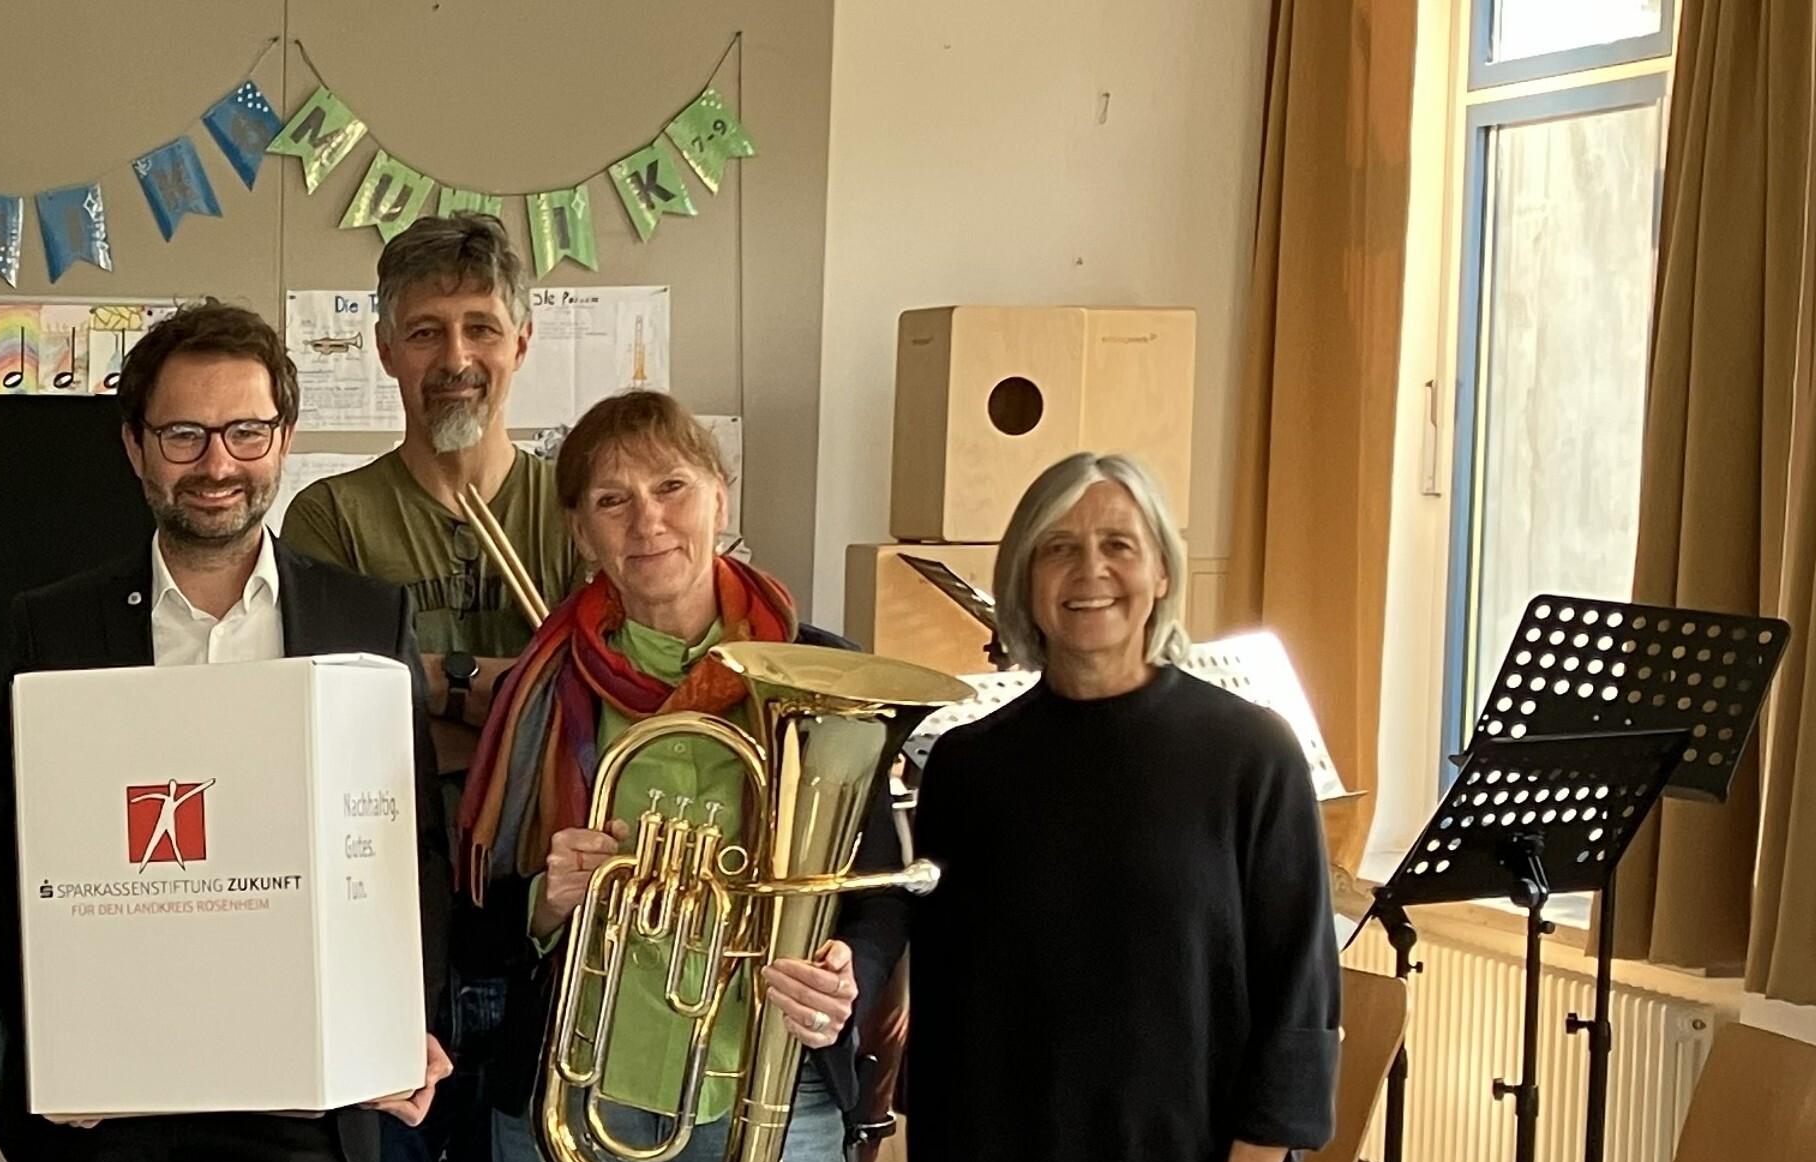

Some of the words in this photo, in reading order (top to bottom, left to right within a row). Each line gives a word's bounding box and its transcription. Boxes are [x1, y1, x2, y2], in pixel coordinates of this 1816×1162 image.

[290, 105, 677, 251] MUIK
[690, 119, 728, 153] 7-9
[334, 295, 359, 314] Die
[344, 790, 400, 822] Nachhaltig.
[56, 878, 224, 899] SPARKASSENSTIFTUNG
[227, 874, 302, 892] ZUKUNFT
[71, 903, 96, 917] FÜR
[98, 903, 124, 916] DEN
[126, 900, 194, 915] LANDKREIS
[196, 898, 269, 912] ROSENHEIM
